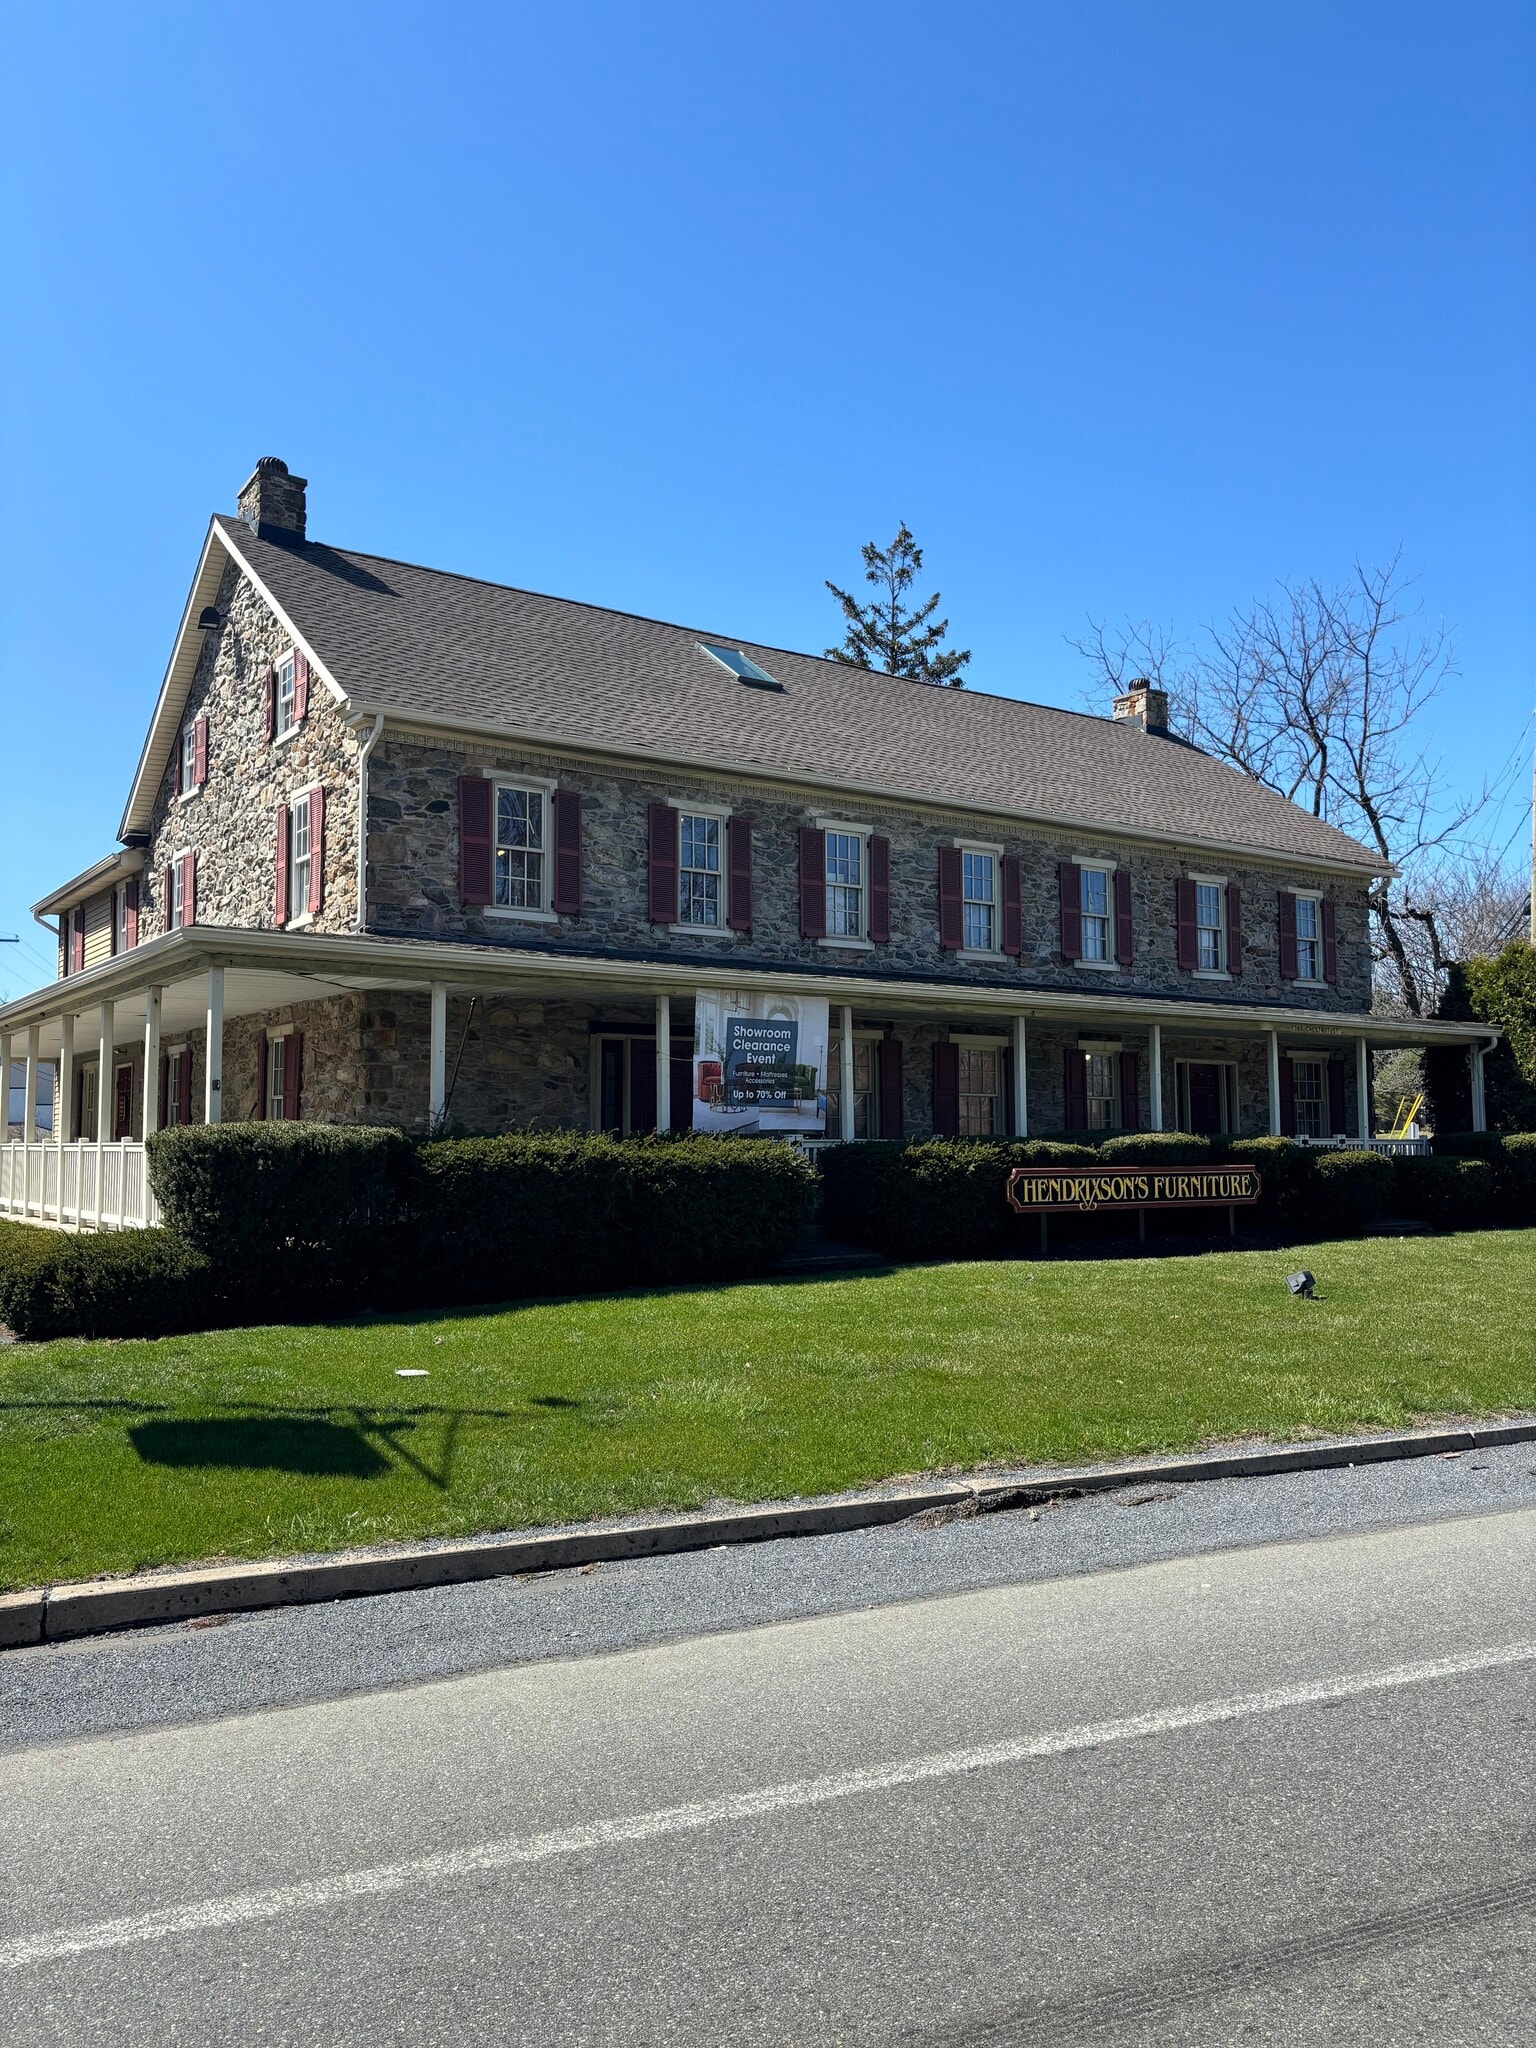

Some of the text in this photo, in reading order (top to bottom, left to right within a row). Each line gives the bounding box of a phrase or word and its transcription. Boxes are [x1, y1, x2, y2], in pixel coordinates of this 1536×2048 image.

[734, 1025, 791, 1039] Showroom
[733, 1039, 791, 1052] Clearance
[747, 1053, 776, 1064] Event
[733, 1089, 787, 1100] Up to 70% Off
[1023, 1174, 1252, 1211] HENDRIXSON'S FURNITURE
